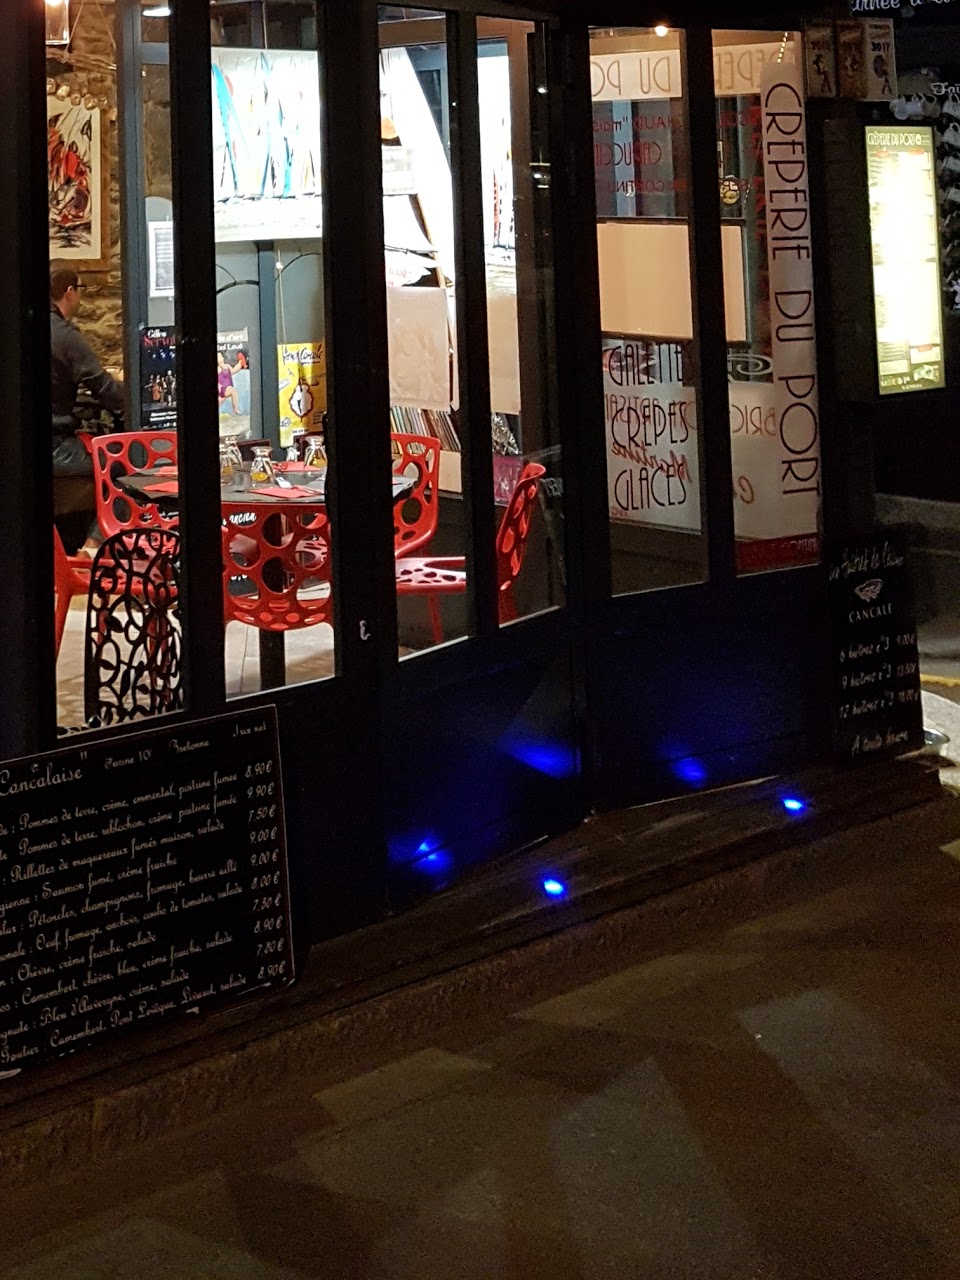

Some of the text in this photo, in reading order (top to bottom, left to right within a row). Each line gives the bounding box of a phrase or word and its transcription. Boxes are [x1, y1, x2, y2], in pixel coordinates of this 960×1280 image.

[764, 82, 811, 262] CREPERIE
[775, 290, 814, 344] DU
[611, 401, 689, 449] CREPES
[777, 373, 821, 498] PORT
[614, 462, 687, 511] GLACES
